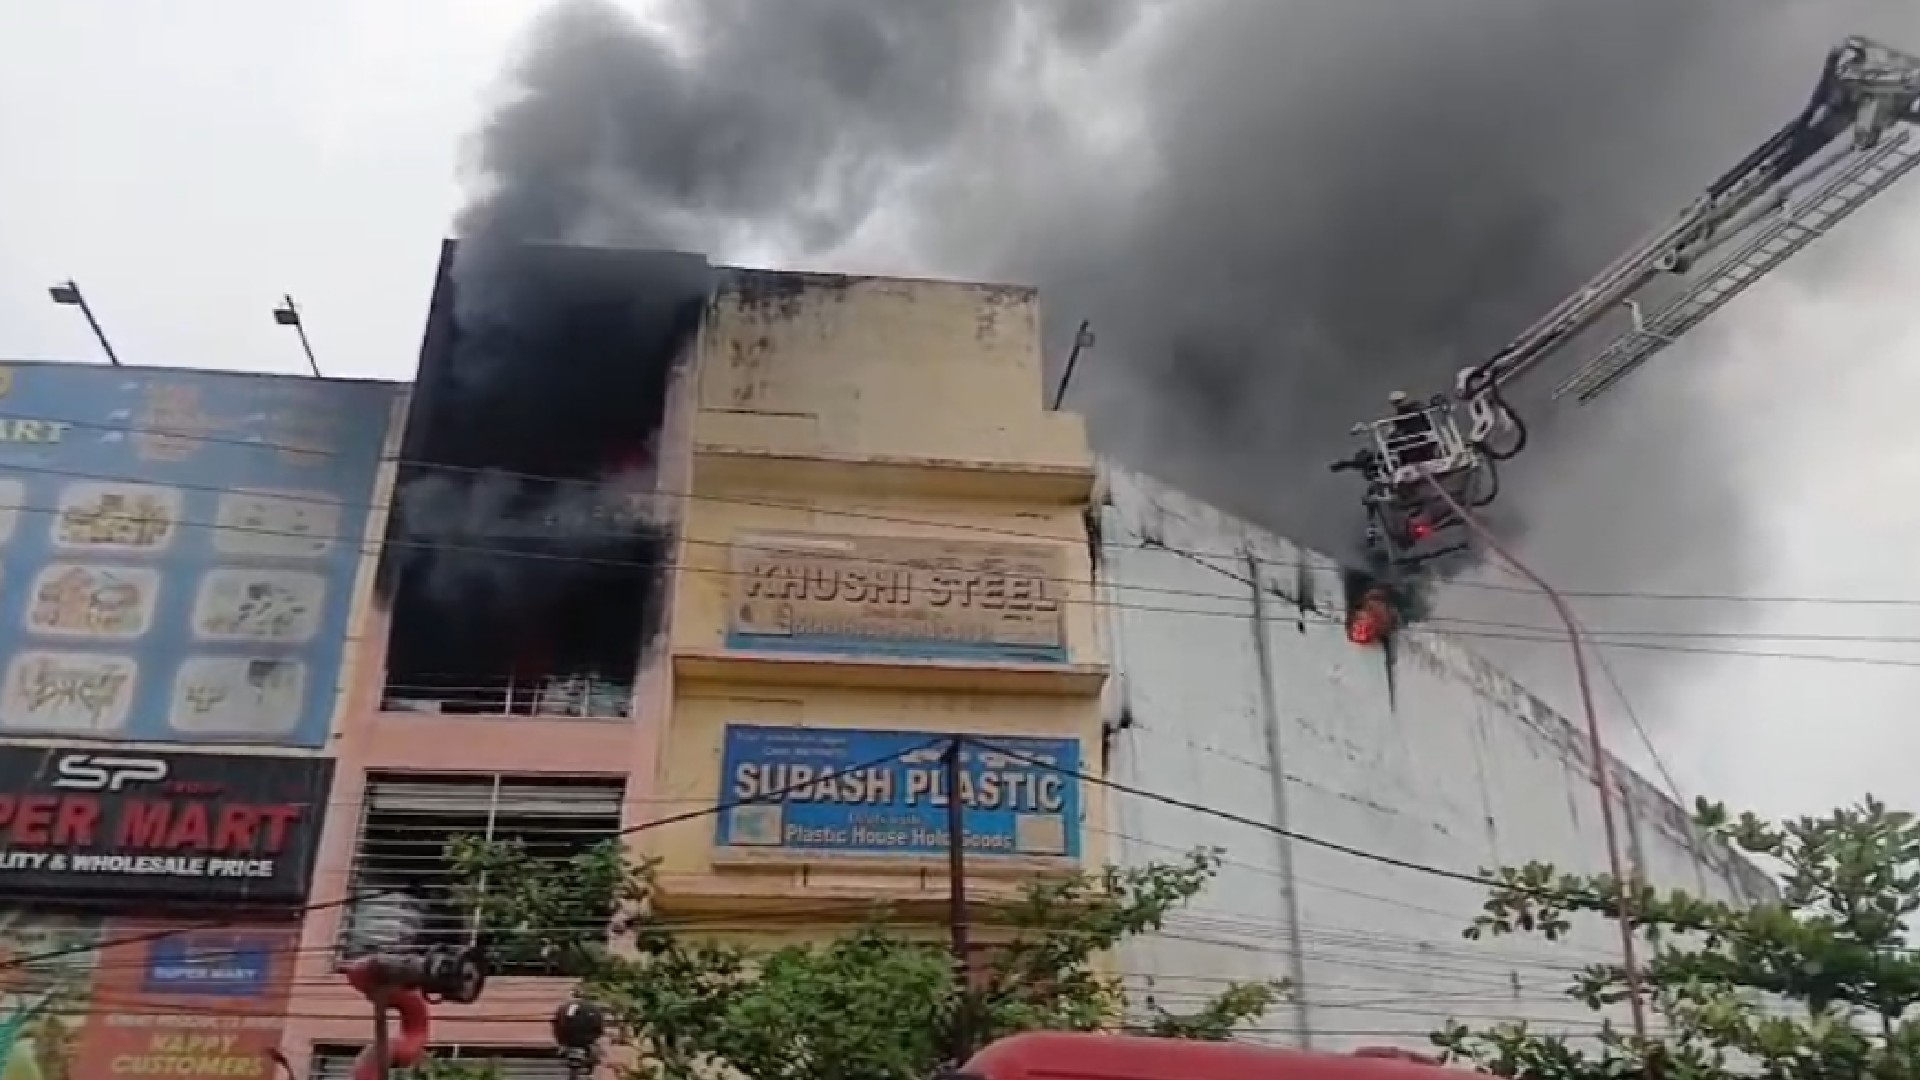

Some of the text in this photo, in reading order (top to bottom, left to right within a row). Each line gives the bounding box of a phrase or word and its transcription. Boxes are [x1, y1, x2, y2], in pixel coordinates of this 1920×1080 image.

[746, 566, 912, 605] KHUSHI
[930, 577, 1058, 612] STEEL
[735, 762, 1064, 811] SUBASH PLASTIC
[116, 799, 300, 853] MART
[786, 823, 848, 843] Plastic
[851, 825, 907, 846] House
[72, 855, 206, 876] WHOLESALE
[207, 860, 274, 877] PRICE
[149, 1033, 240, 1053] HAPPY
[111, 1054, 264, 1076] CUSTOMERS
